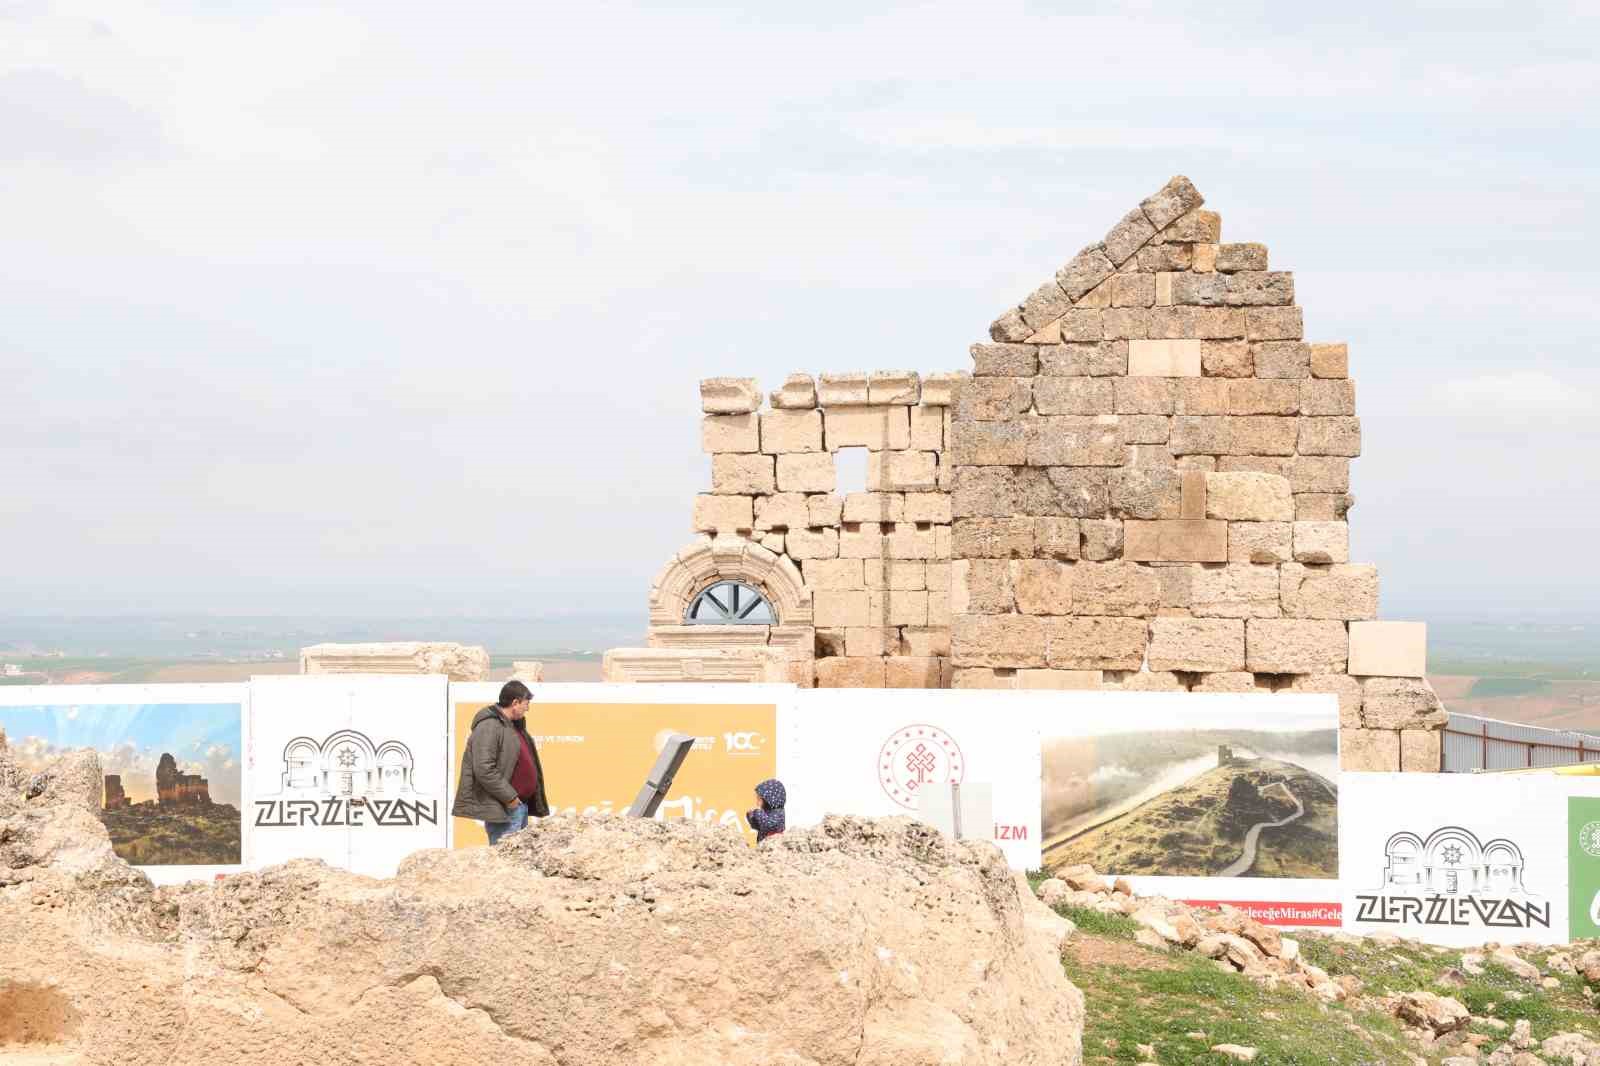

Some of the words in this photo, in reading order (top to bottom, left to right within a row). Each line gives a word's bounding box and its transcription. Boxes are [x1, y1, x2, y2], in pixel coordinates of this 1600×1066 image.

[255, 796, 437, 827] ZERZEVAN
[993, 822, 1027, 840] İZM
[1355, 894, 1550, 928] ZERZEVAN
